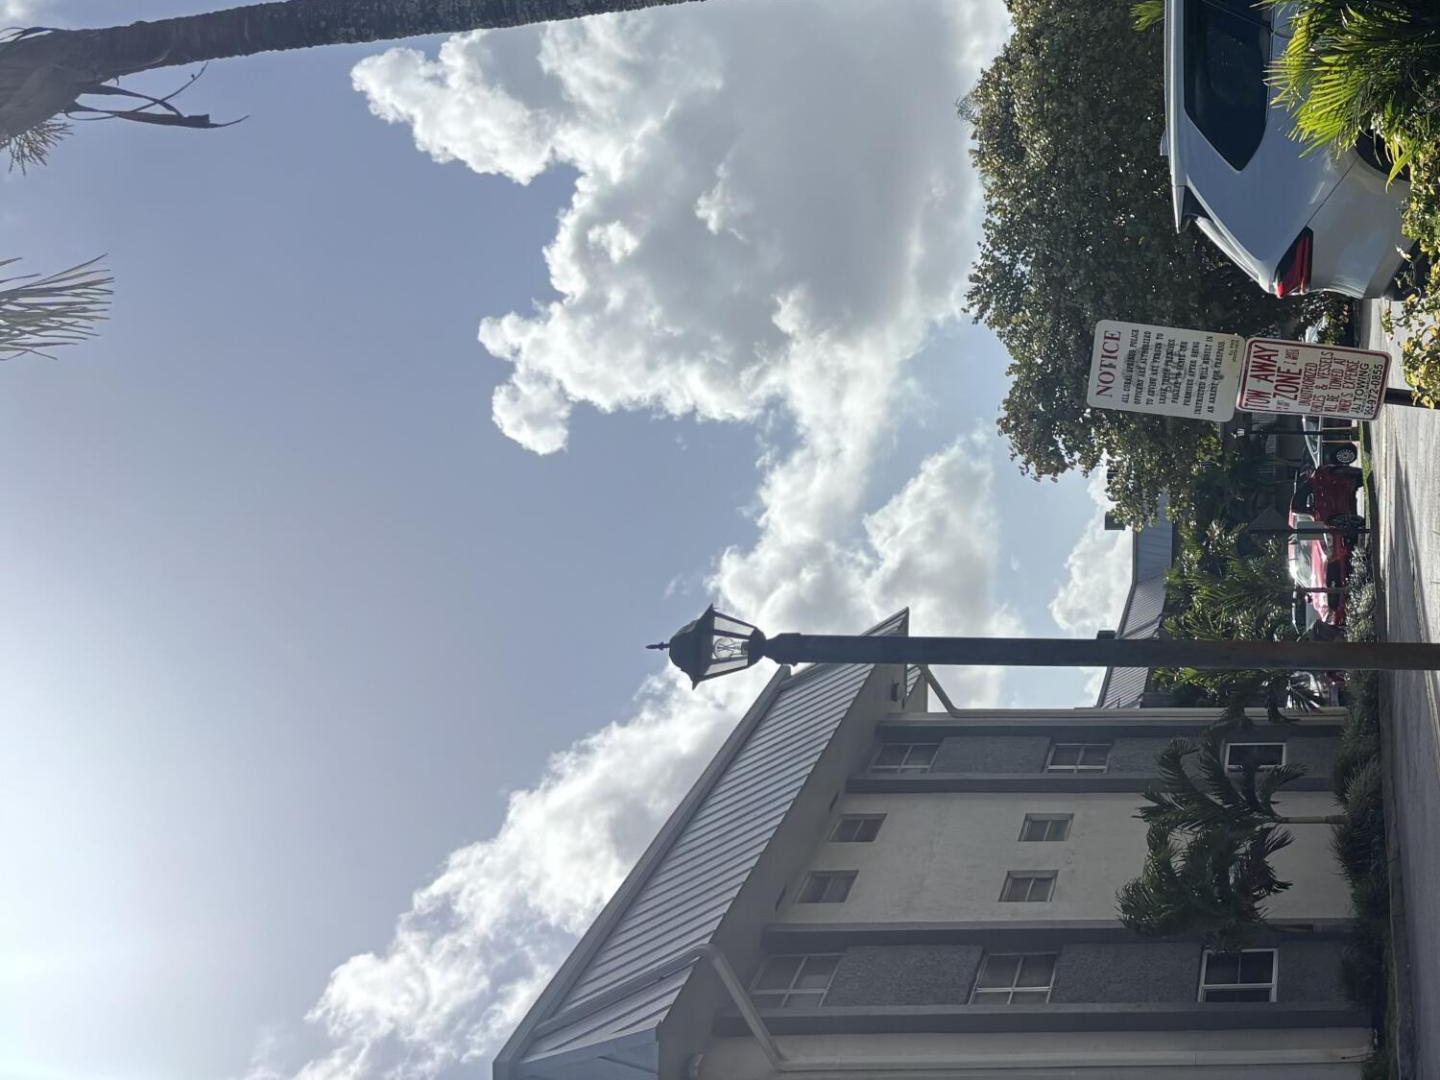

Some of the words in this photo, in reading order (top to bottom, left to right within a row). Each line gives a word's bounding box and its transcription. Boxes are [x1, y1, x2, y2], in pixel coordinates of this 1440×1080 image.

[1096, 331, 1121, 398] NOTICE
[1249, 345, 1279, 383] AWAY
[1342, 360, 1360, 389] EXPENSE
[1353, 363, 1369, 401] TOWING
[1244, 389, 1271, 408] TOW
[1273, 366, 1302, 400] ZONE
